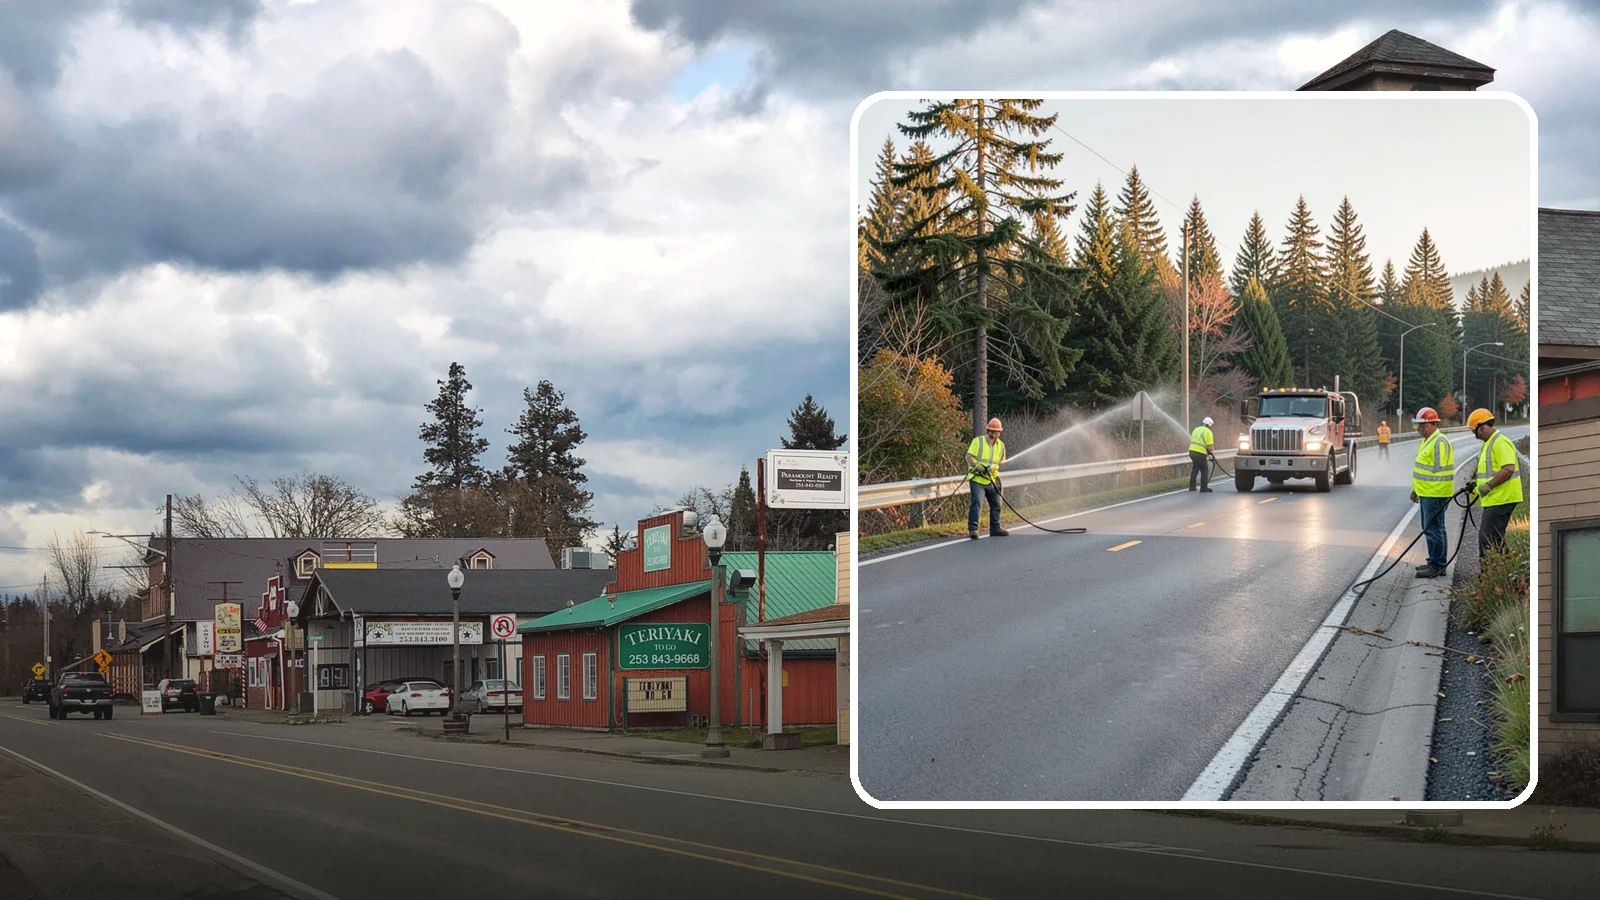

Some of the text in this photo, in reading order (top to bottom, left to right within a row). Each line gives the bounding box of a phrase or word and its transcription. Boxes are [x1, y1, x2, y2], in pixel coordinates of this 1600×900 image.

[781, 471, 815, 480] PARAMOUNT
[817, 472, 839, 481] REALTY
[646, 531, 669, 549] TERIYAKI
[625, 627, 702, 646] TERIYAKI
[629, 653, 700, 665] 253 843-9668
[639, 681, 673, 691] TERIYAKI
